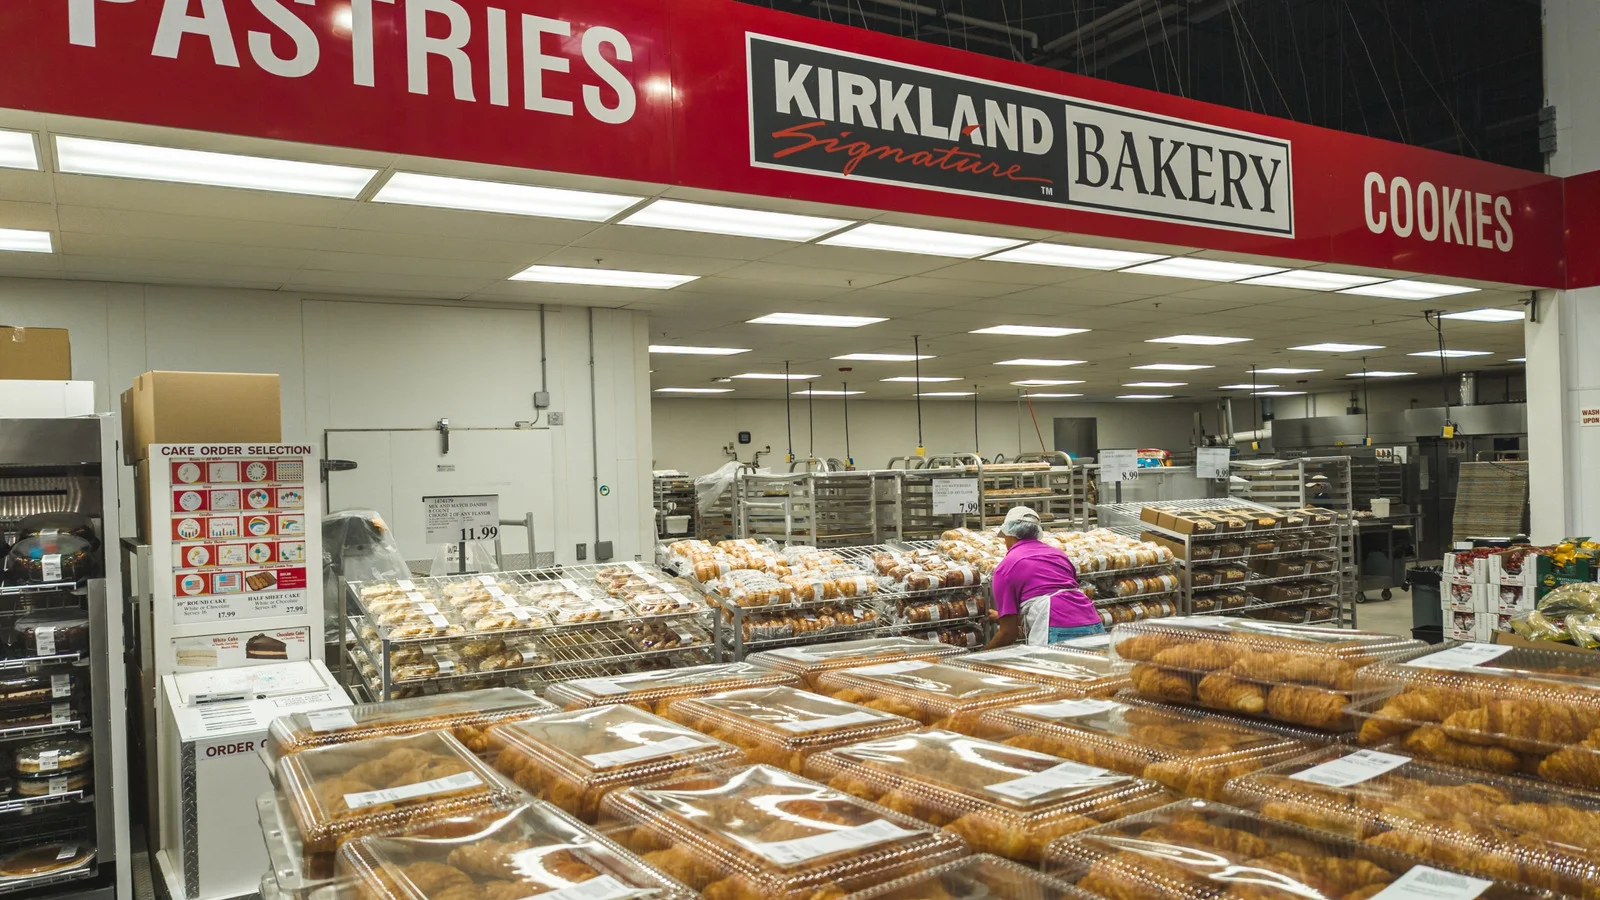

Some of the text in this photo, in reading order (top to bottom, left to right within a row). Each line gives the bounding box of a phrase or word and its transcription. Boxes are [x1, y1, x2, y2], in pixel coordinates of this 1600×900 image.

[774, 59, 1054, 155] KIRKLAND
[772, 121, 1053, 176] Signature
[1072, 120, 1281, 213] BAKERY
[1041, 187, 1053, 196] TM
[1364, 171, 1513, 252] COOKIES
[162, 446, 311, 456] CAKE ORDER SELECTION
[1122, 471, 1138, 480] 8.99
[1216, 469, 1229, 478] 9.99
[960, 503, 978, 513] 7.99
[460, 526, 498, 540] 11.99
[206, 741, 254, 757] ORDER
